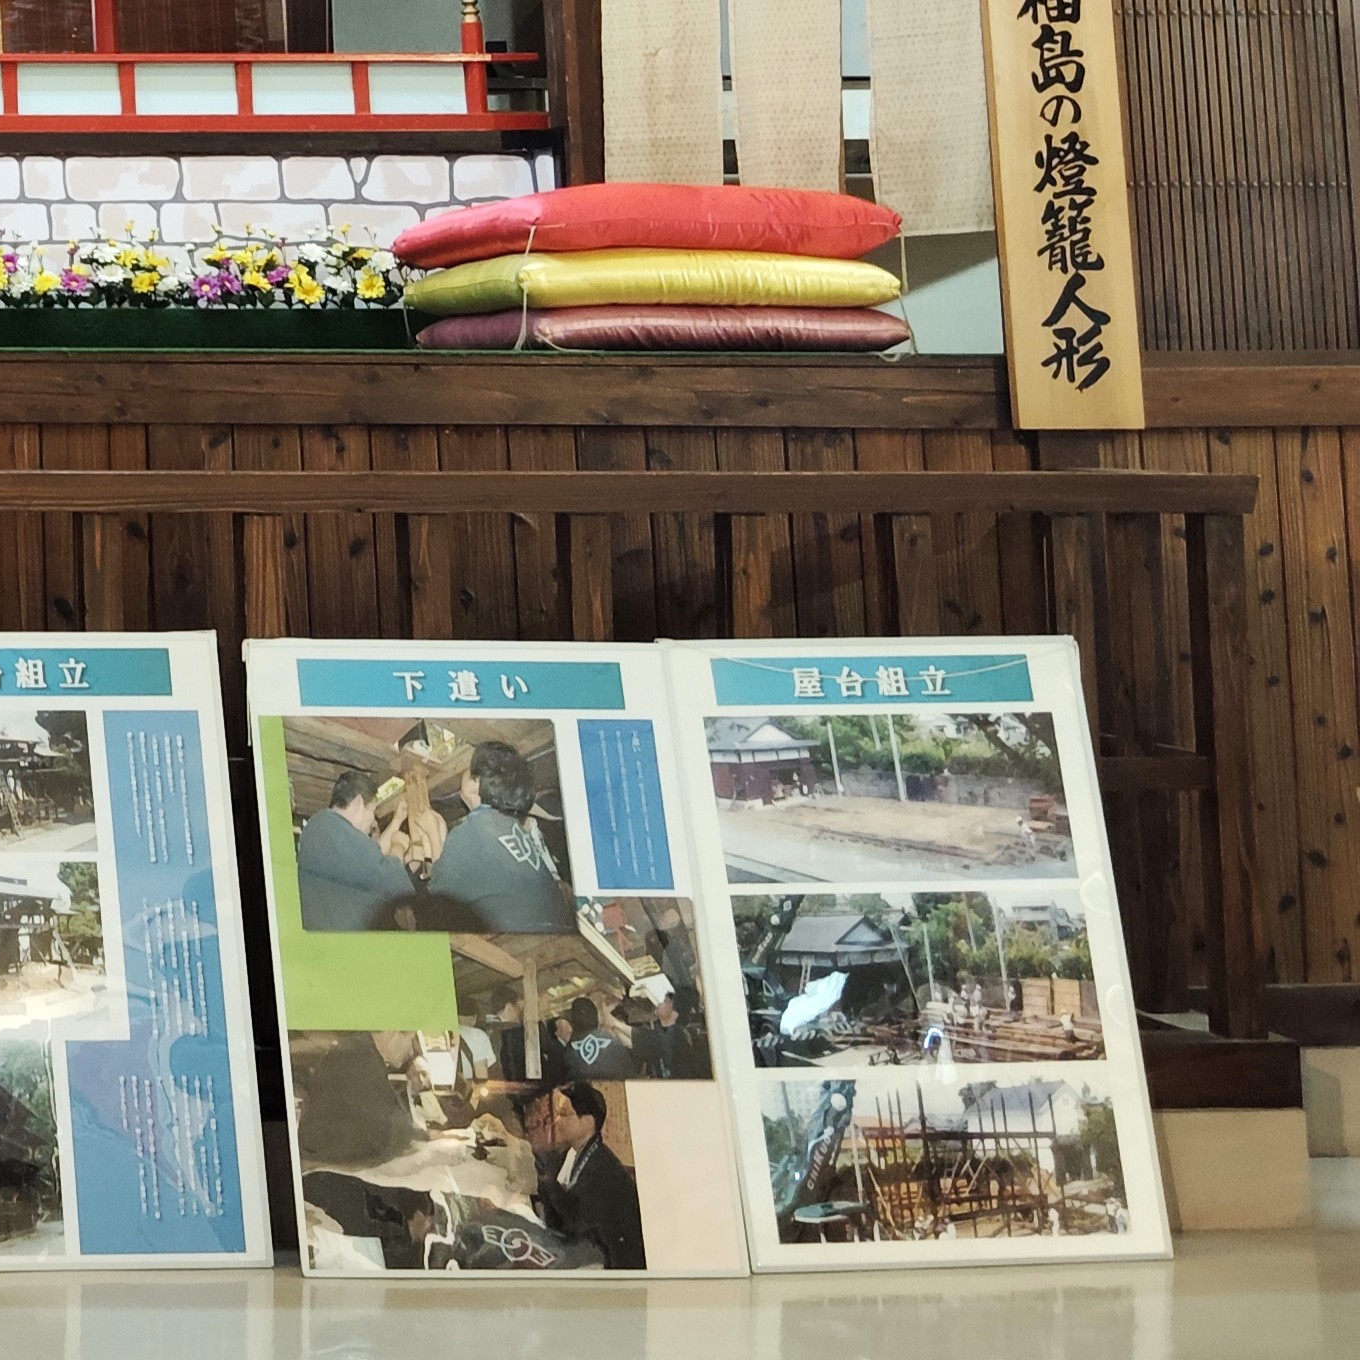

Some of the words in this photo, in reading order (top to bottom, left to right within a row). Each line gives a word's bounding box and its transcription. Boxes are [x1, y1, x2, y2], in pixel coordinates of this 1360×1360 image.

[393, 669, 530, 703] 下遣い
[792, 665, 952, 698] 屋台組立
